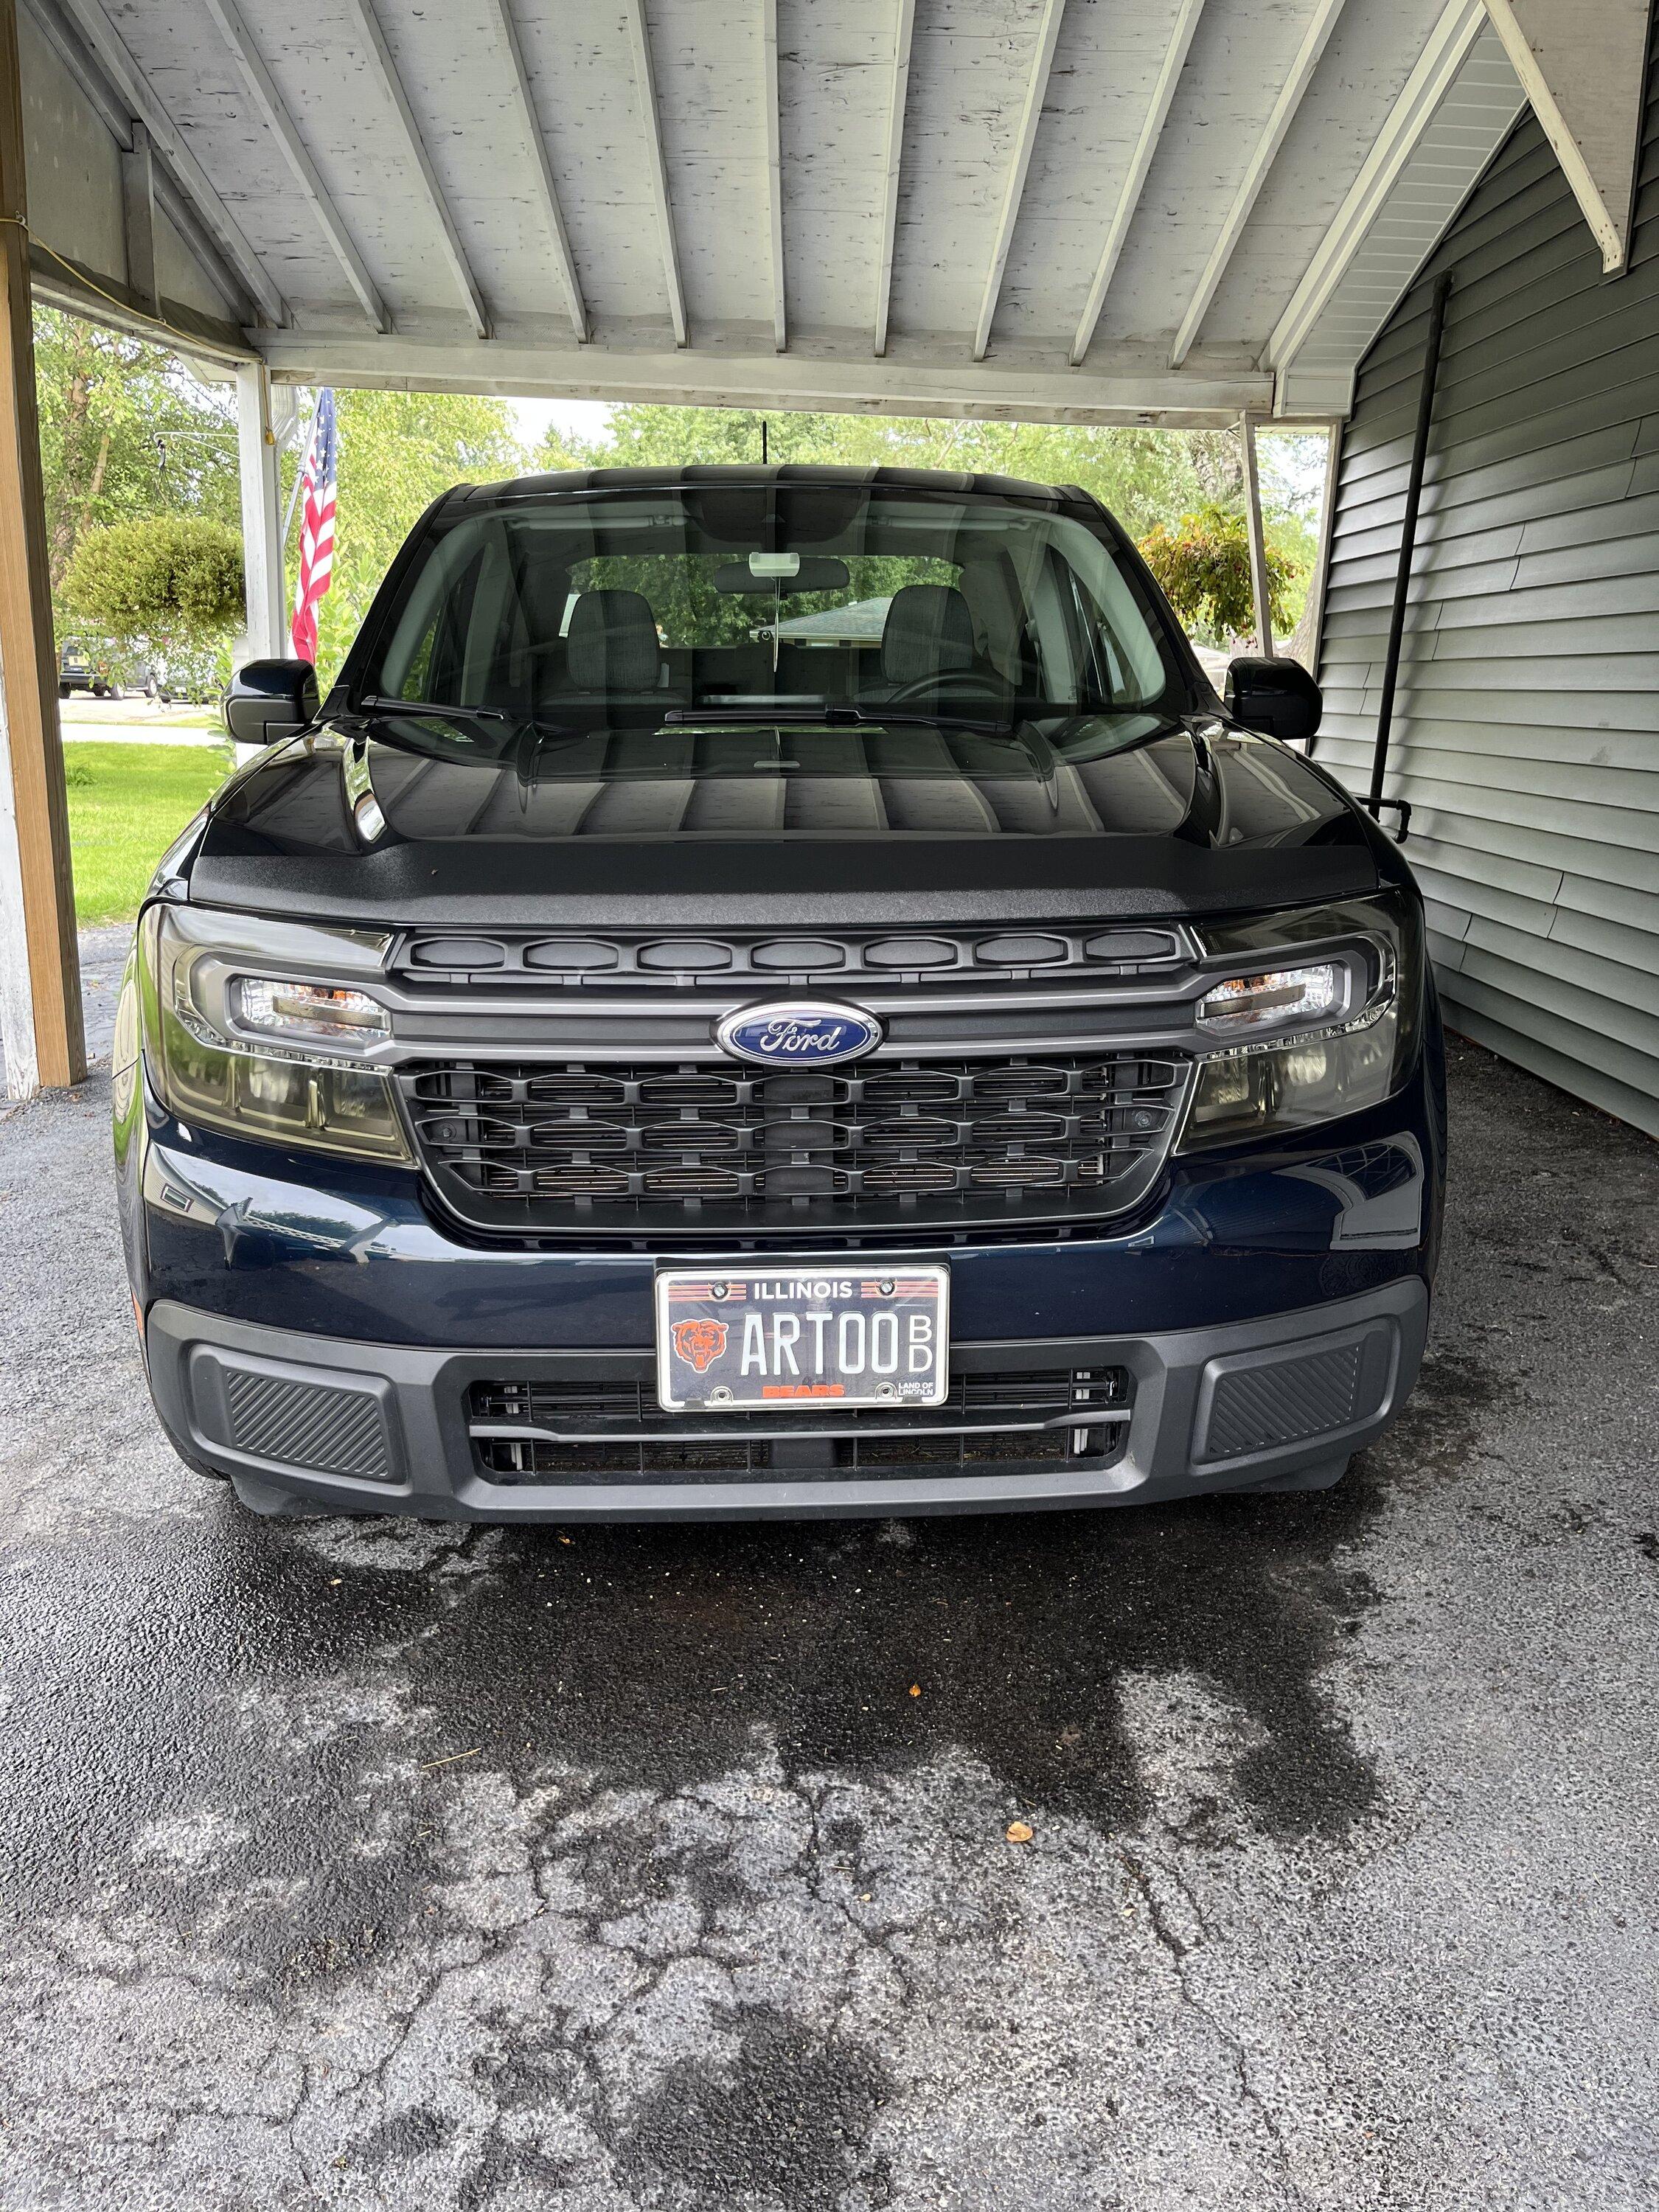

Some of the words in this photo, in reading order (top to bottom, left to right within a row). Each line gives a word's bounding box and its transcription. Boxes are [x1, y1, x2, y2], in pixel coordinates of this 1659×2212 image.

[759, 1018, 840, 1051] Ford
[754, 1281, 853, 1300] ILLINOIS
[762, 1384, 845, 1398] BEARS
